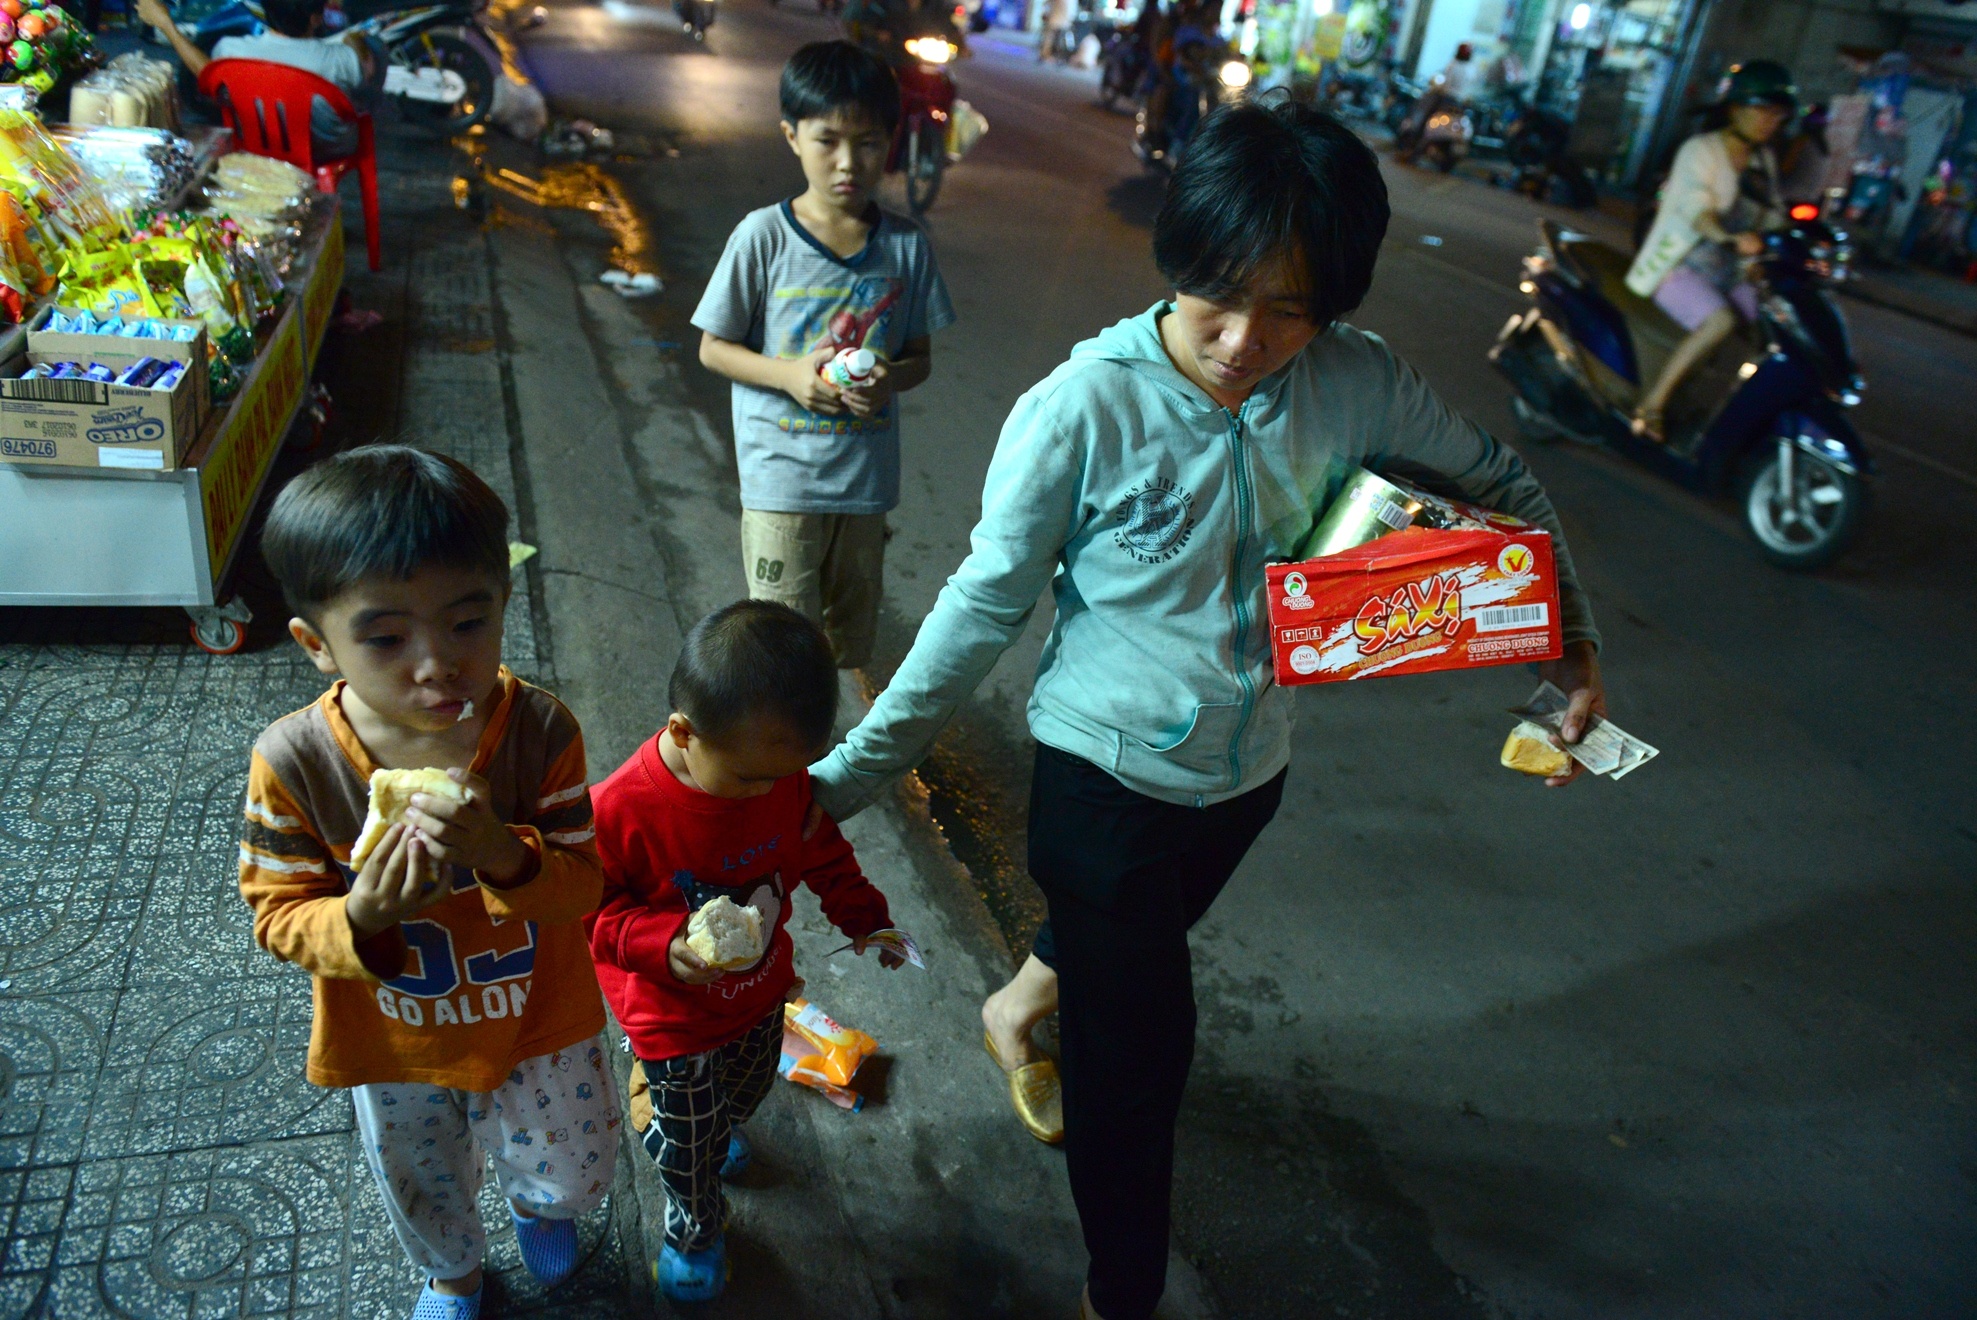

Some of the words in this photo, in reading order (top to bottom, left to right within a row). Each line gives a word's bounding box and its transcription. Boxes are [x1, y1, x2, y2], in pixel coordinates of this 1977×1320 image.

[86, 417, 165, 443] OREO
[3, 440, 54, 456] 970476
[1157, 476, 1195, 509] TRENDS
[1114, 518, 1195, 564] GENERATION
[756, 557, 784, 583] 69
[1298, 652, 1312, 660] ISO
[376, 987, 424, 1027] GO
